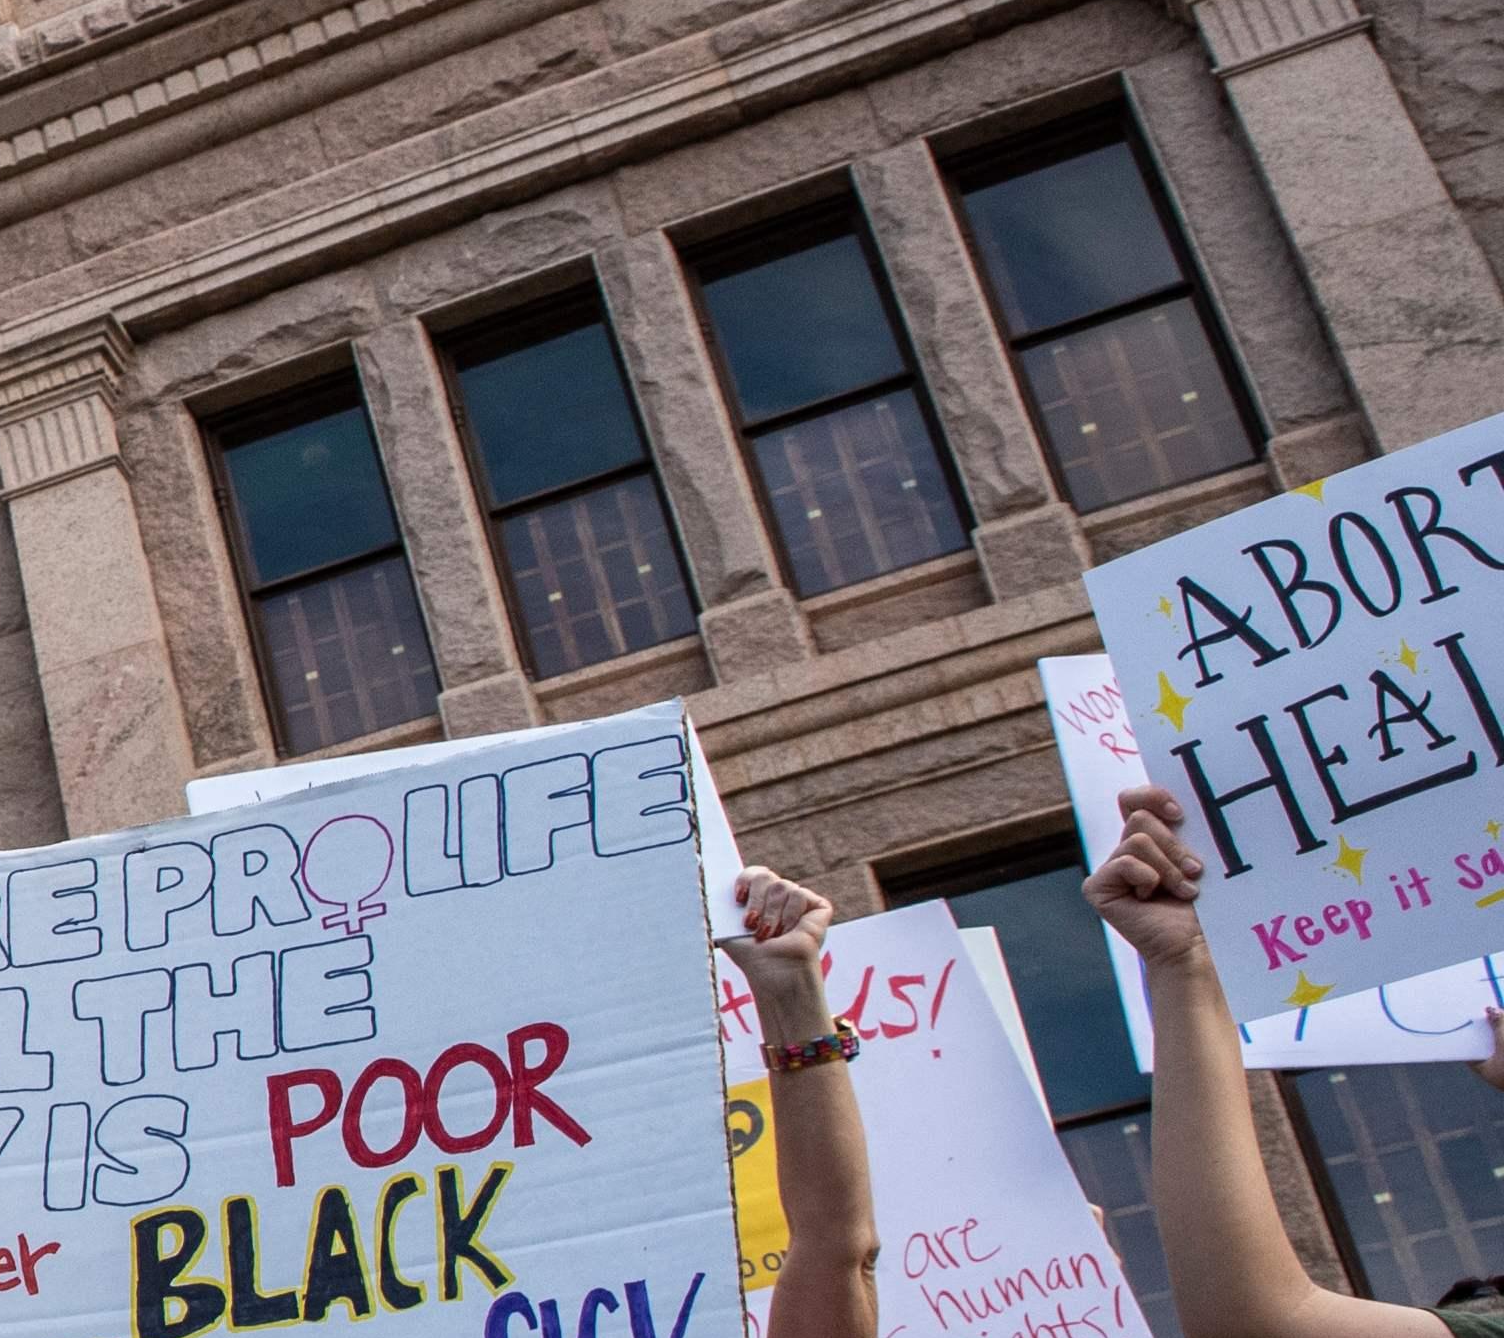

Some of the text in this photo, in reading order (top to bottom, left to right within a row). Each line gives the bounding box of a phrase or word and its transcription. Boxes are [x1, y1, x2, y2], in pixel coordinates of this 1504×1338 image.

[402, 734, 696, 897] LIFE
[1251, 868, 1432, 970] Keep it
[73, 935, 379, 1086] THE
[43, 1094, 190, 1211] IS
[265, 1022, 593, 1188] POOR
[903, 1218, 1002, 1280] are
[921, 1252, 1108, 1329] human
